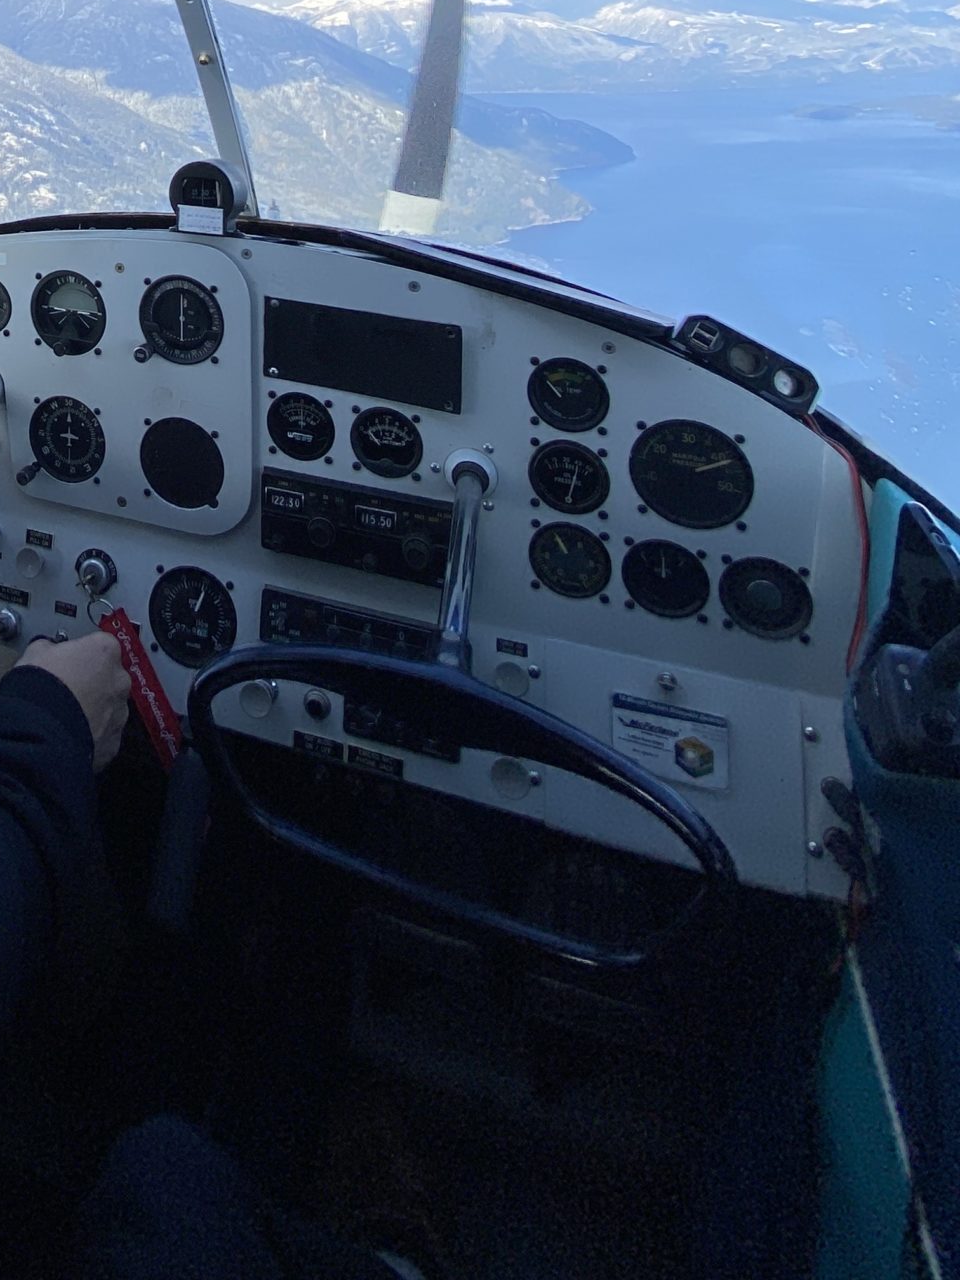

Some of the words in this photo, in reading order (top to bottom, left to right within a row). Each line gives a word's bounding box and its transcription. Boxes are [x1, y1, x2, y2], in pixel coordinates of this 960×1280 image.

[681, 432, 696, 444] 30
[654, 443, 667, 454] 20
[554, 476, 582, 486] PRESSRE
[718, 480, 733, 492] 50
[271, 495, 300, 508] 122.30
[361, 512, 392, 528] 115.50
